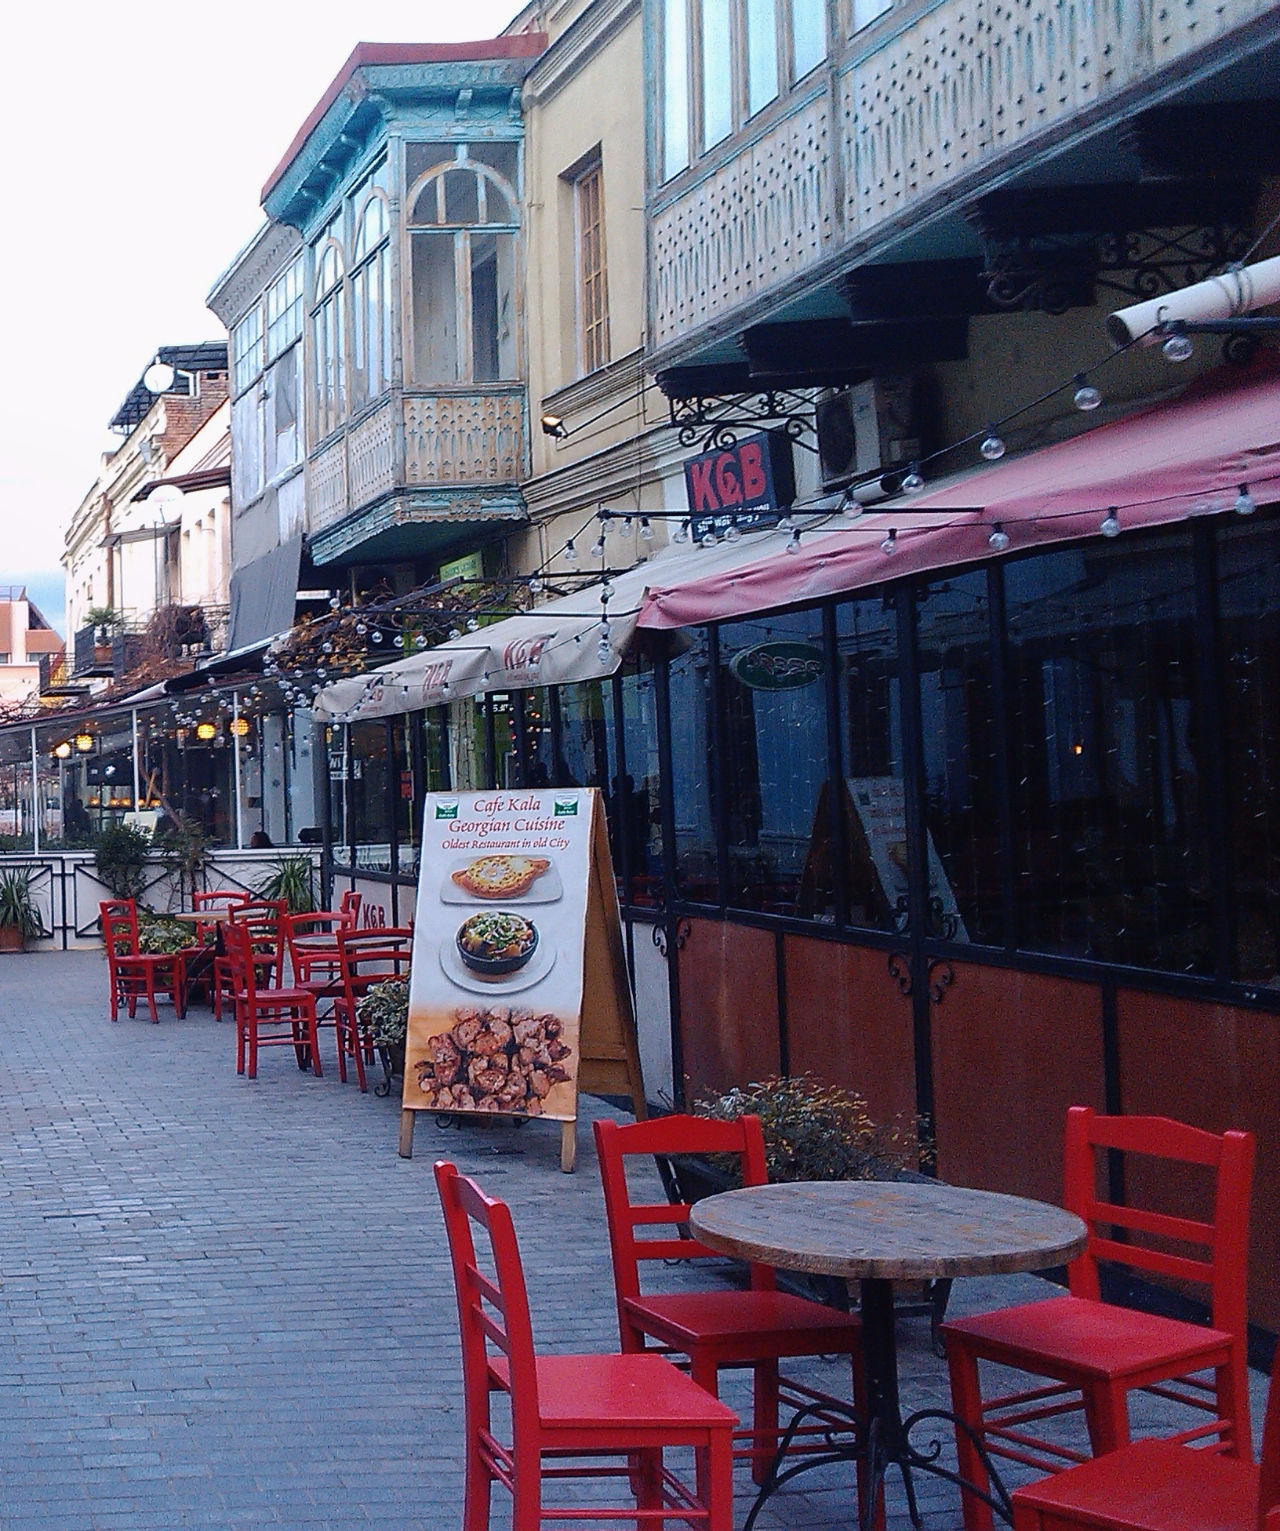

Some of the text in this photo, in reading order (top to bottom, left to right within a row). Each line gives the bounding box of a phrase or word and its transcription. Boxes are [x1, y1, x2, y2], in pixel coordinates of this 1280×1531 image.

[690, 442, 766, 511] KGB
[473, 797, 504, 816] Cafe
[508, 795, 541, 812] Kala
[448, 816, 565, 837] Georgian Cuisine
[442, 837, 570, 850] Oldest Restaurant in old City
